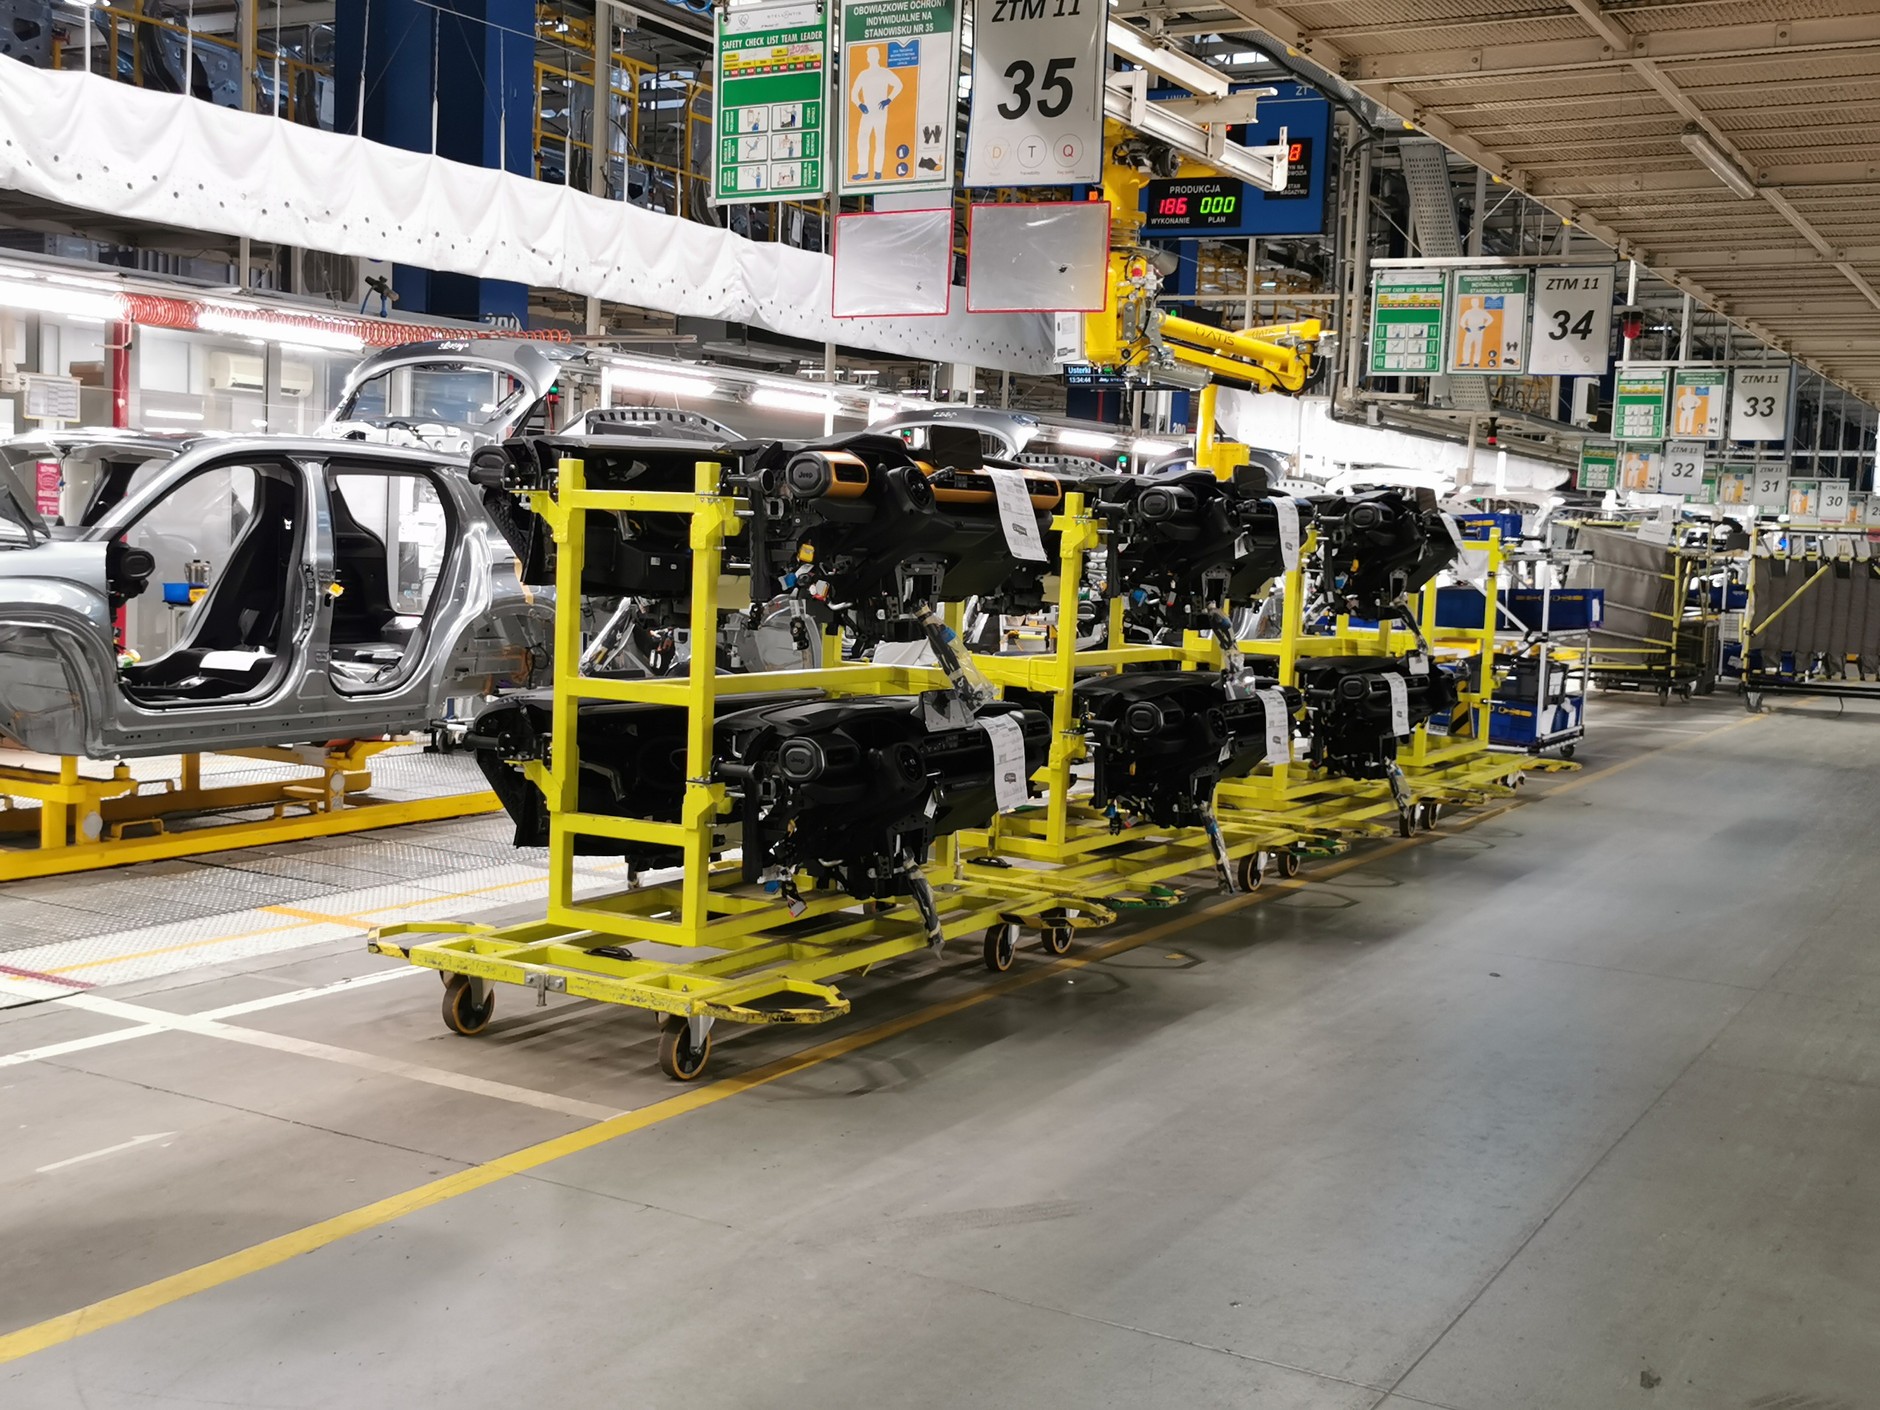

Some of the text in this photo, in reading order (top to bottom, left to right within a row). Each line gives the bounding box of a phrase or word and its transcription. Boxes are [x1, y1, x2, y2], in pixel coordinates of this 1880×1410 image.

[853, 2, 908, 15] OBOWIĄZKOWE
[866, 12, 932, 26] INDYWIDUALNE NA
[864, 23, 934, 38] STANOWISKU NR 35
[722, 31, 822, 50] SAFETY CHECK LIST TEAM LEADER
[997, 58, 1076, 120] 35
[1028, 146, 1036, 158] T
[1062, 144, 1074, 157] Q
[1169, 185, 1221, 194] PRODUKCJA
[1159, 196, 1236, 215] 186 000
[1546, 278, 1599, 290] ZTM 11
[1548, 310, 1595, 341] 34
[1741, 375, 1779, 383] ZTM 11
[1744, 396, 1775, 417] 33
[1671, 462, 1694, 478] 32
[1761, 480, 1779, 492] 31
[1826, 496, 1843, 506] 30
